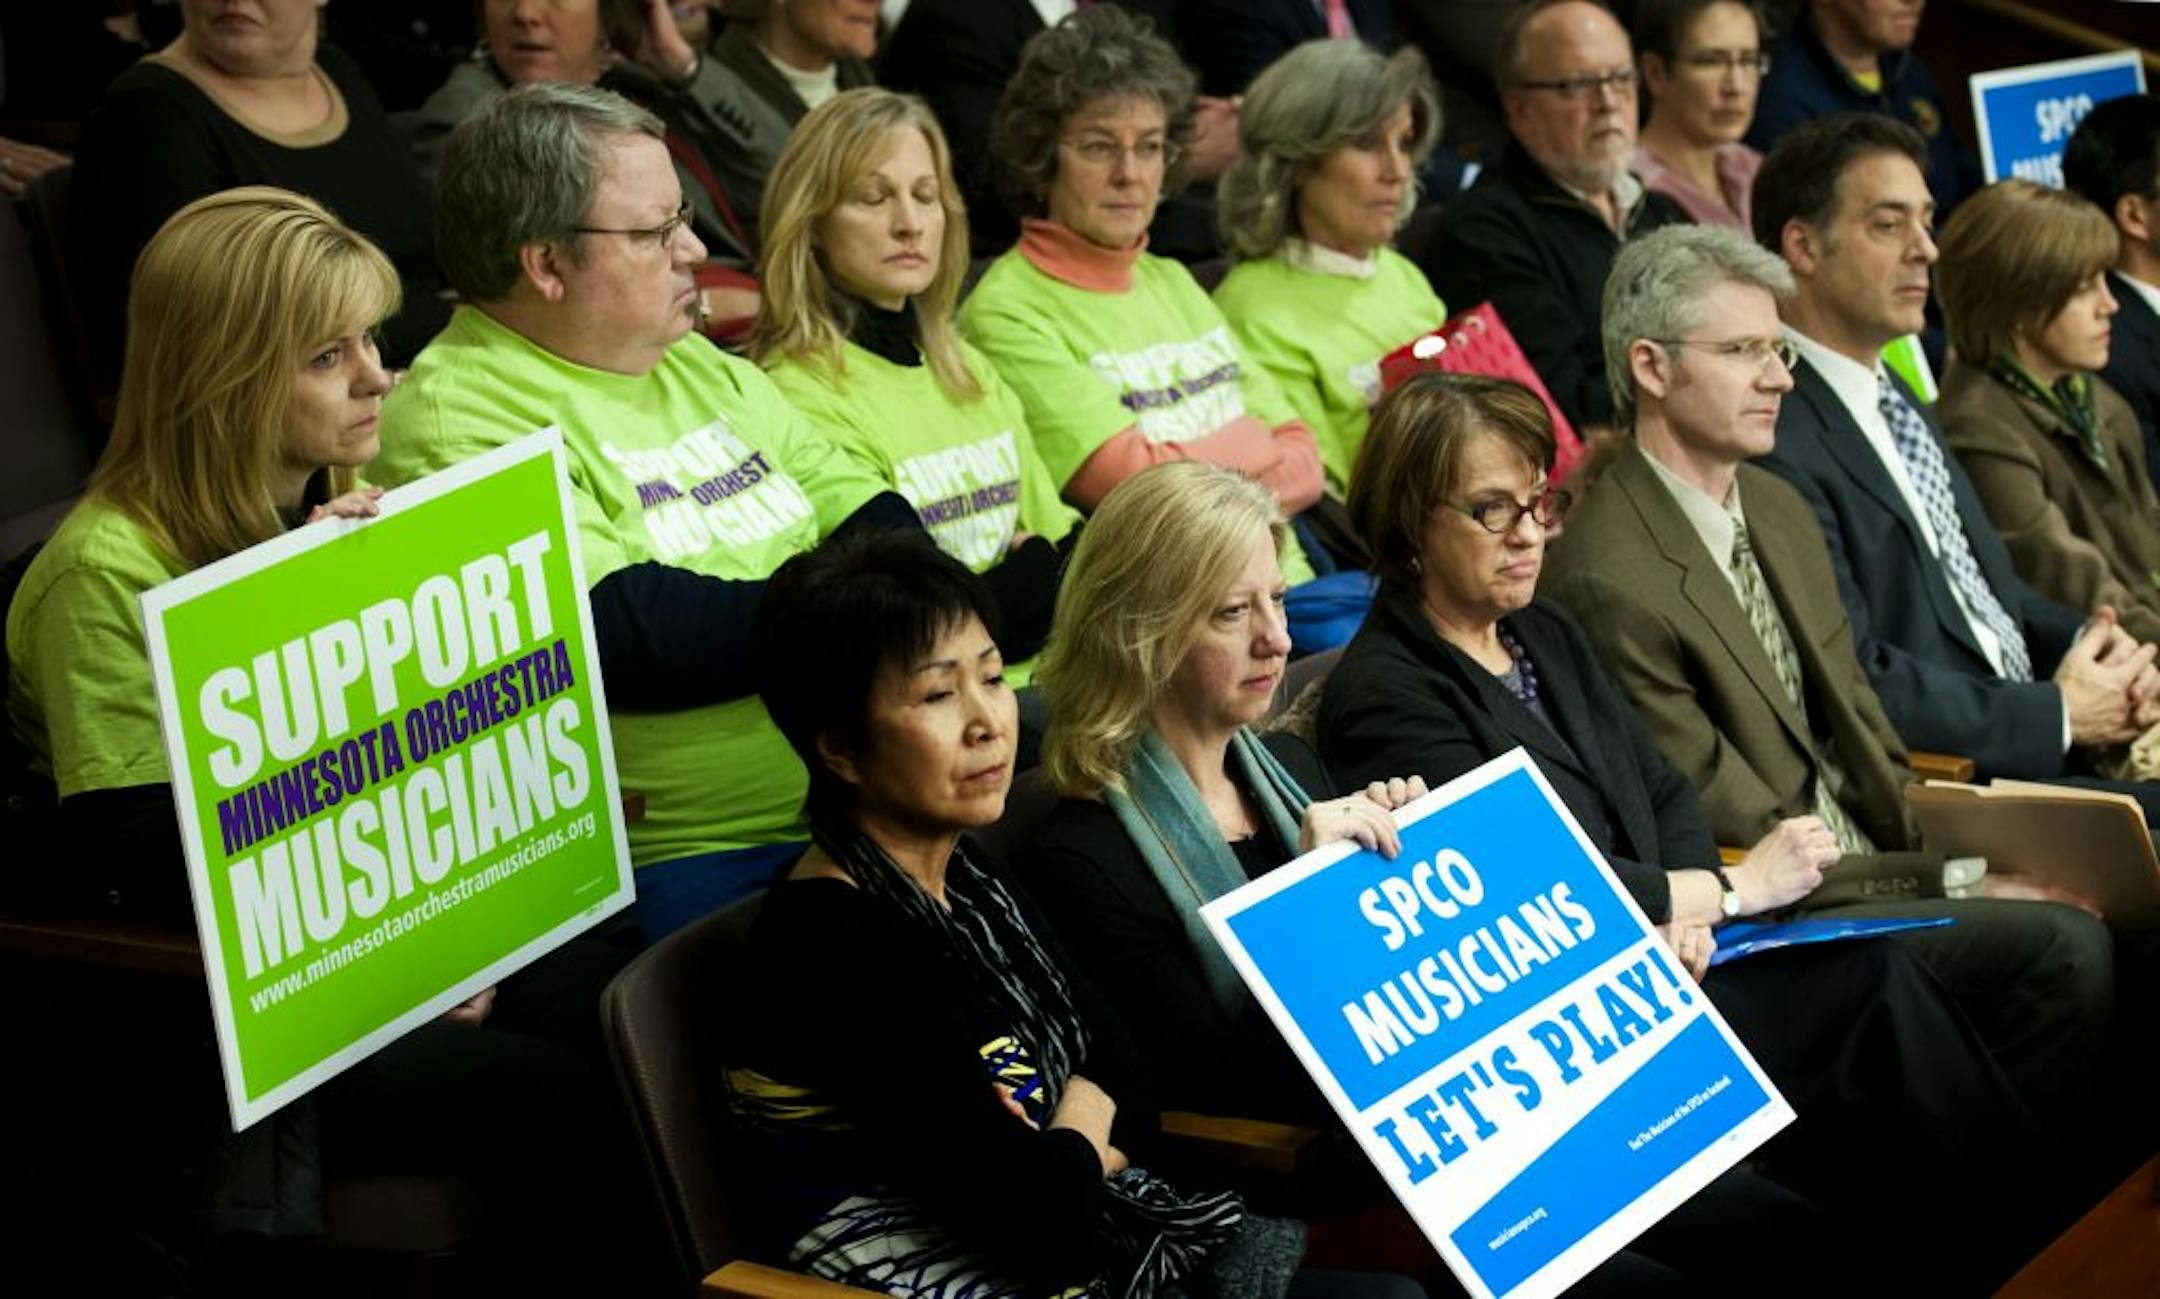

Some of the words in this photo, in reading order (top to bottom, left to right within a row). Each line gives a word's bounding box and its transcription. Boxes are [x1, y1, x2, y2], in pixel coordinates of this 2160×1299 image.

[690, 450, 772, 507] ORCHEST
[199, 530, 554, 789] SUPPORT
[217, 718, 405, 857] MINNESOTA
[405, 638, 576, 763] ORCHESTRA
[228, 697, 592, 981] MUSICIANS
[249, 810, 596, 1014] www.minnesotaorchestramusicians.org
[1358, 847, 1484, 951] SPCO
[1341, 881, 1597, 1067] MUSICIANS
[1373, 1045, 1543, 1186] LET'S
[1527, 946, 1694, 1086] PLAY!
